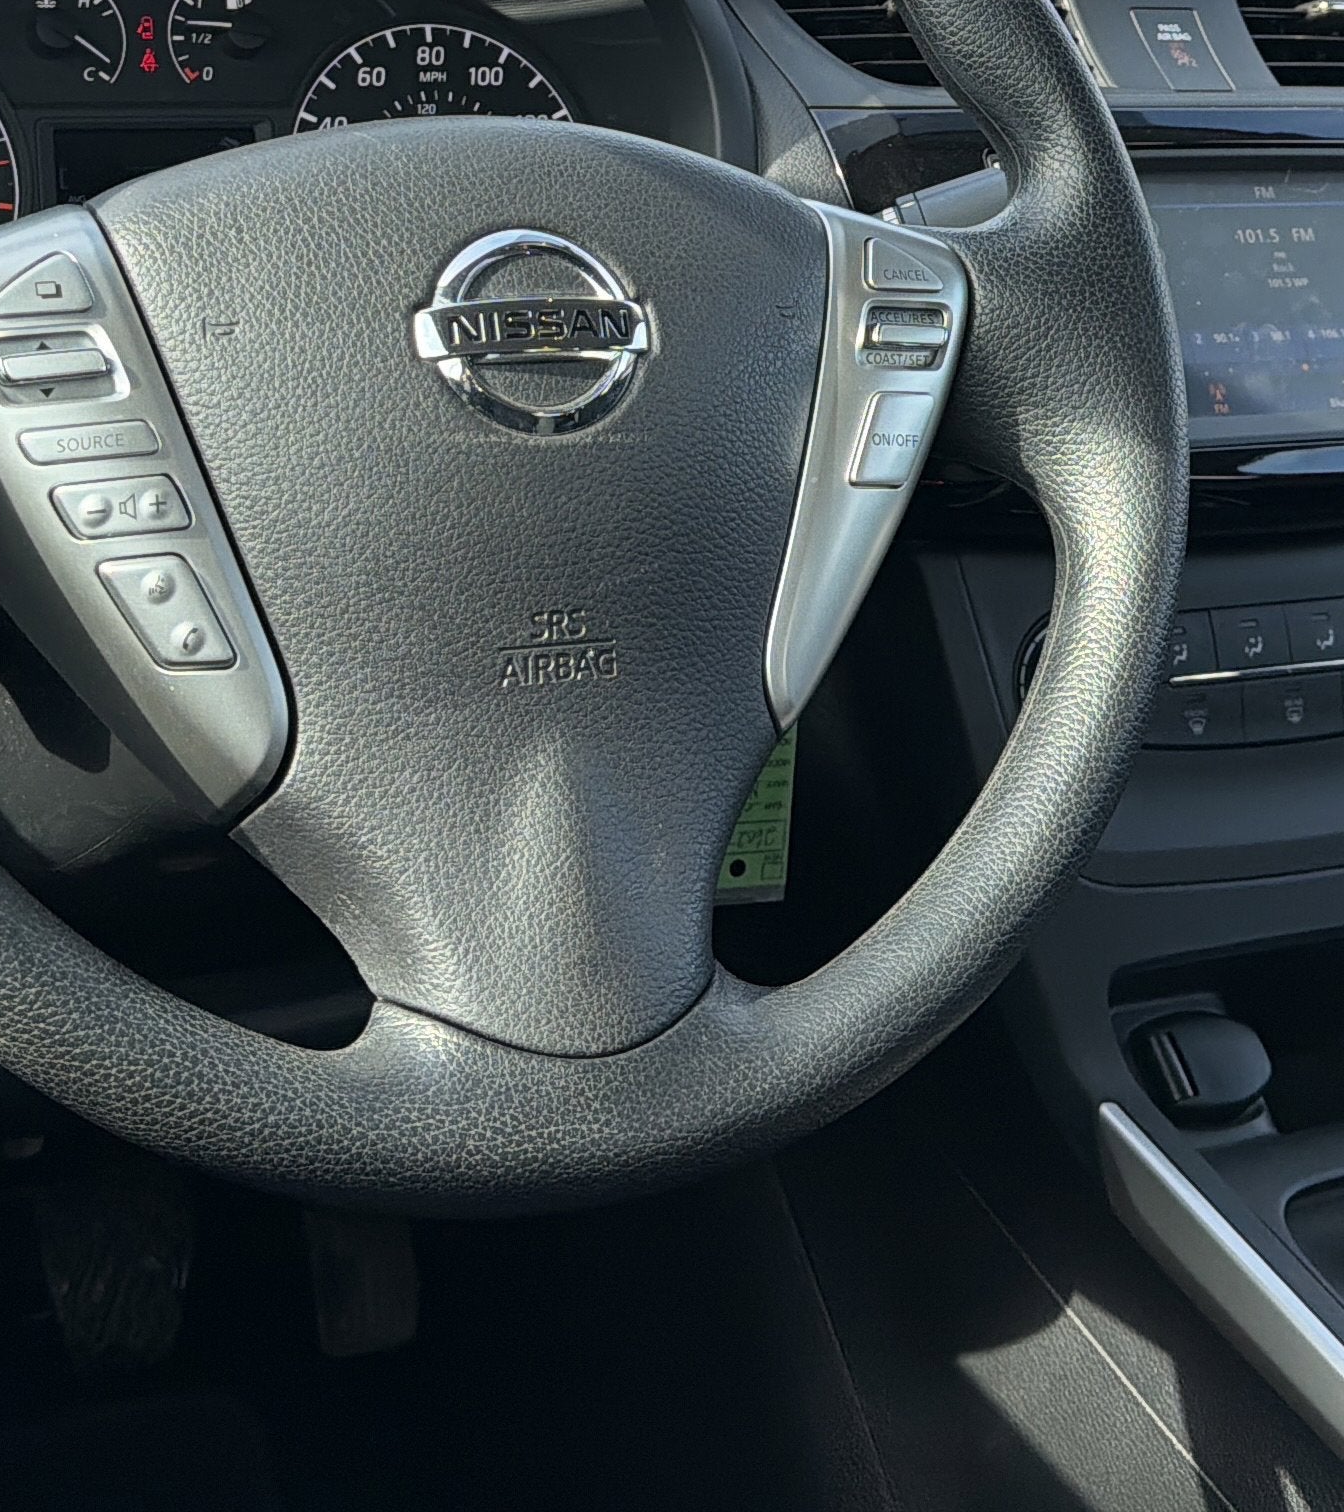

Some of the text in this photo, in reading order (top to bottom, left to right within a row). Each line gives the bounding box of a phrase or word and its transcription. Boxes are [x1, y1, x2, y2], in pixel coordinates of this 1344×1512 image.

[191, 33, 212, 44] 1/2
[416, 46, 445, 66] 80
[83, 67, 96, 81] C
[203, 67, 213, 81] 0
[357, 67, 386, 87] 60
[419, 71, 446, 83] MPH
[468, 67, 504, 86] 100
[417, 103, 436, 115] 120
[1254, 186, 1276, 199] FM
[1237, 228, 1315, 243] 101.5 FM
[884, 269, 929, 282] CANCEL
[871, 311, 934, 324] ACCEL/RES
[447, 308, 630, 346] NISSAN
[866, 352, 930, 367] COAST/SET
[56, 433, 125, 453] SOURCE
[872, 433, 920, 448] ON/OFF
[531, 609, 586, 641] SRS
[498, 648, 617, 688] AIRBAG
